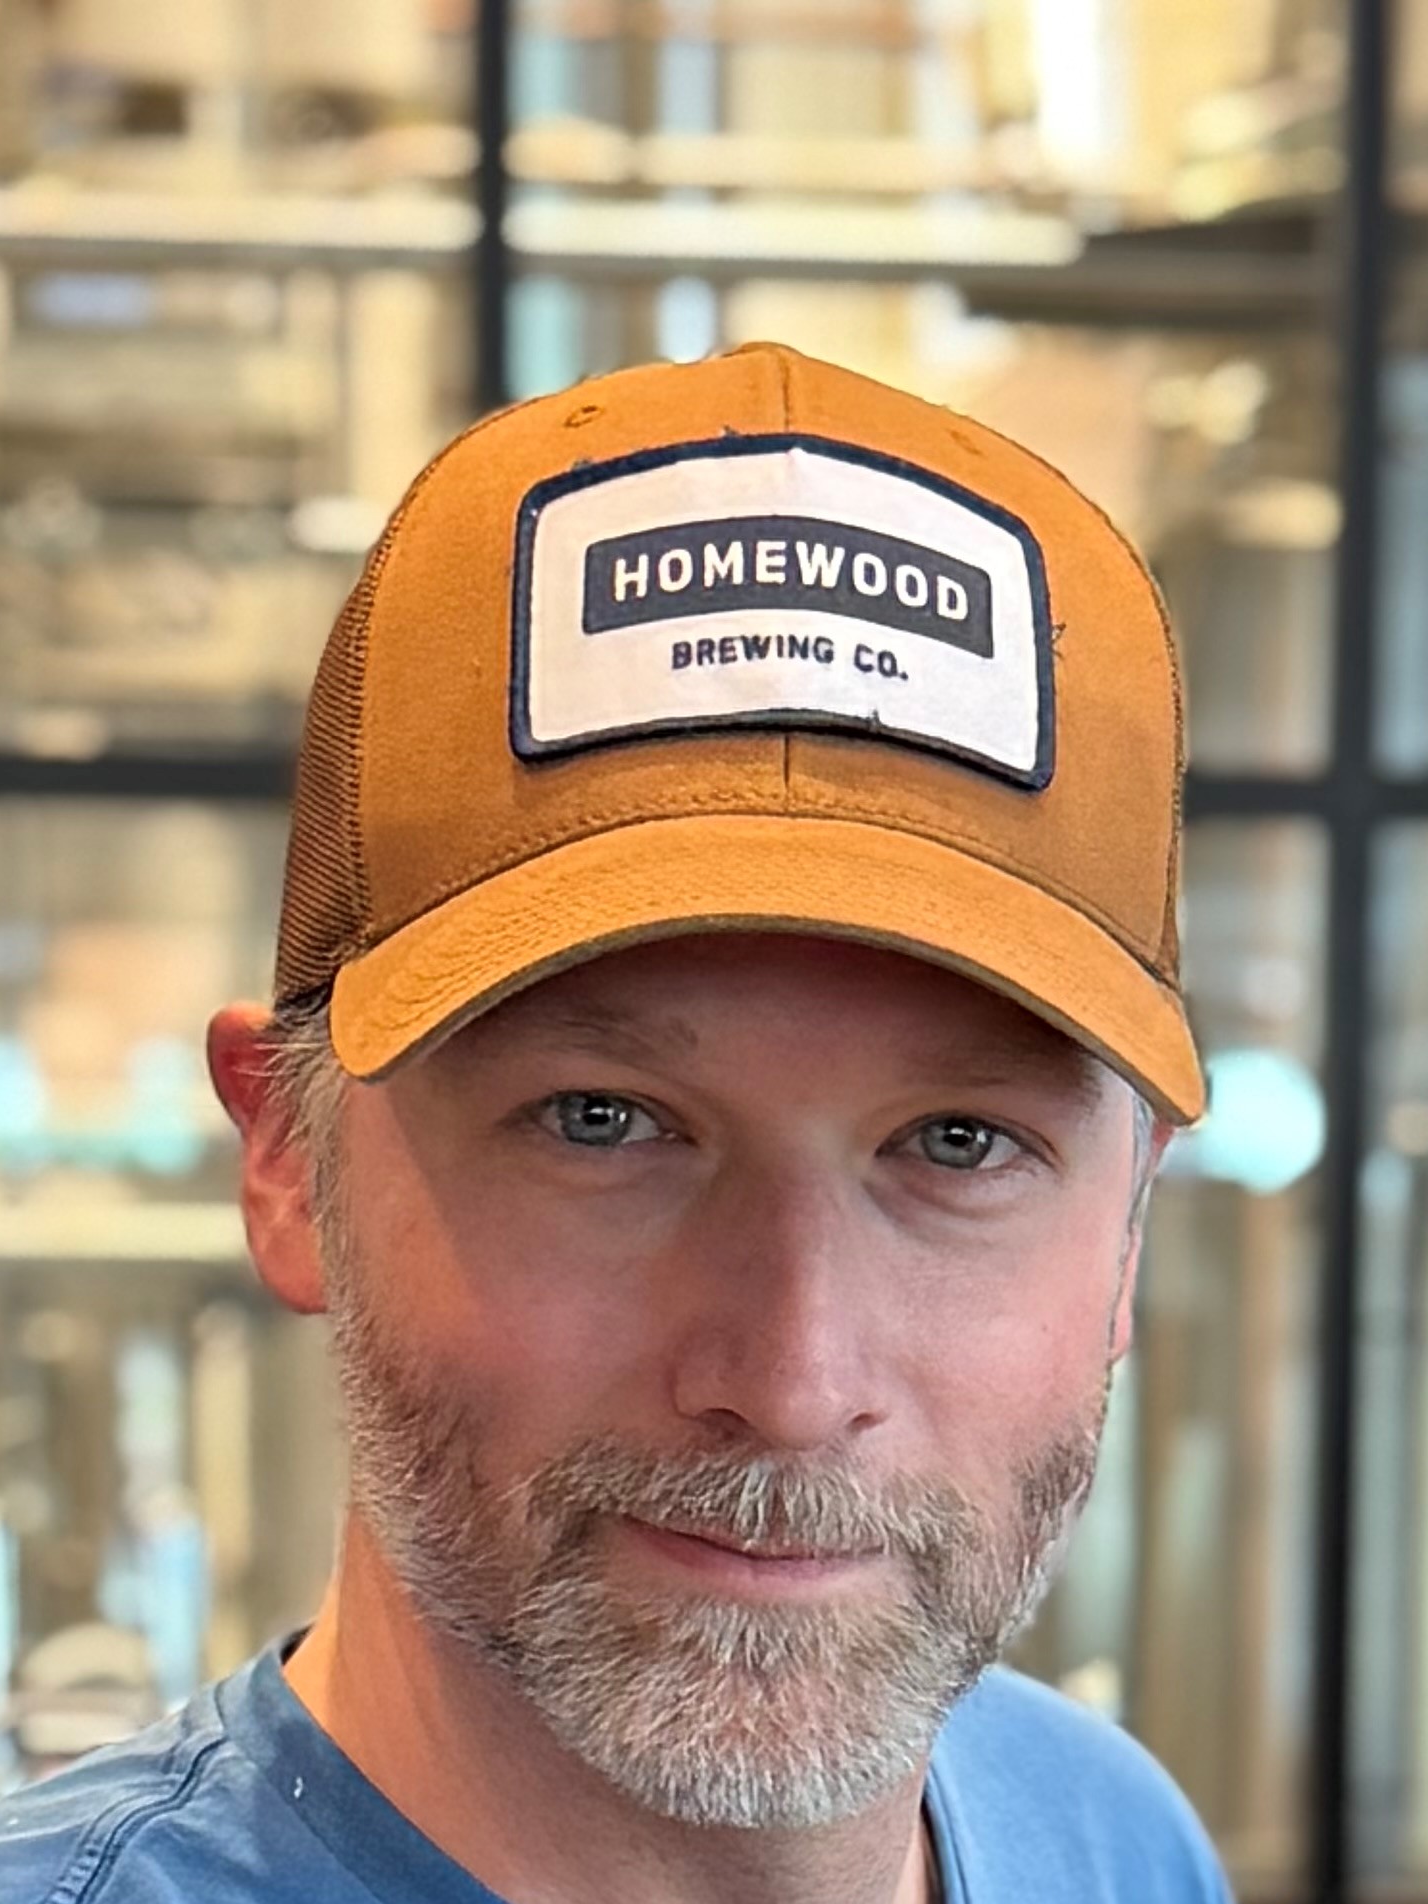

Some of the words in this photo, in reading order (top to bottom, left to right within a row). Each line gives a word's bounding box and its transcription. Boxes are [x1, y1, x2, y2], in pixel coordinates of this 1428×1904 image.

[612, 539, 970, 622] HOMEWOOD
[670, 633, 835, 671] BREWING
[852, 643, 910, 681] CO.
